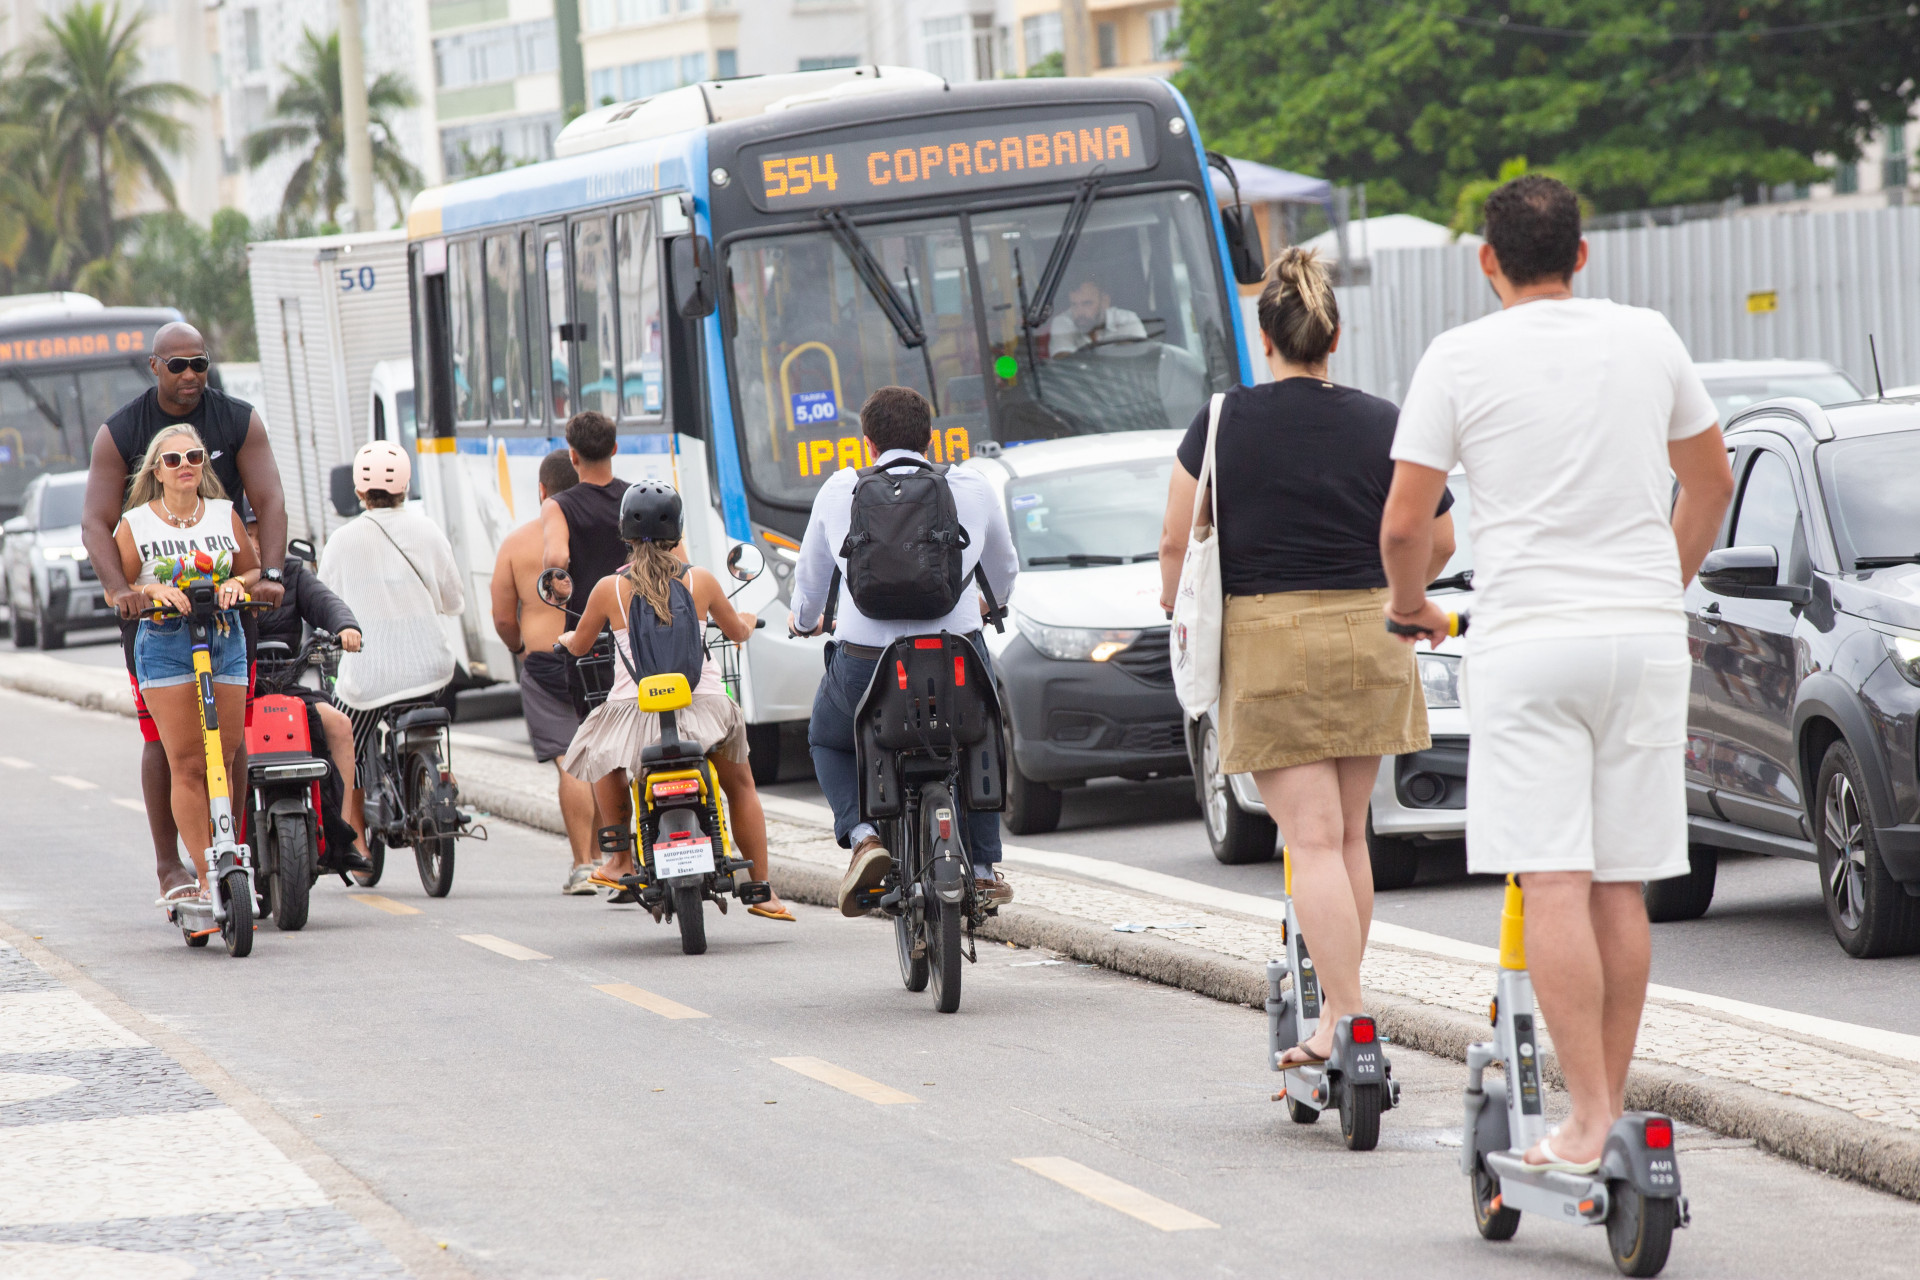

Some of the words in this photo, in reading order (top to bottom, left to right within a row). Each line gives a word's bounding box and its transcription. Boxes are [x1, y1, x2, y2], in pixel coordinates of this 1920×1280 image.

[763, 153, 838, 197] 554
[867, 125, 1131, 186] COPACABANA
[340, 266, 375, 291] 50
[796, 402, 835, 423] 5,00
[140, 539, 200, 561] FAUNA
[204, 534, 235, 551] RIO
[649, 687, 676, 697] Bee
[1357, 1053, 1376, 1062] AU1
[1358, 1064, 1376, 1073] 812
[1650, 1160, 1673, 1171] AU1
